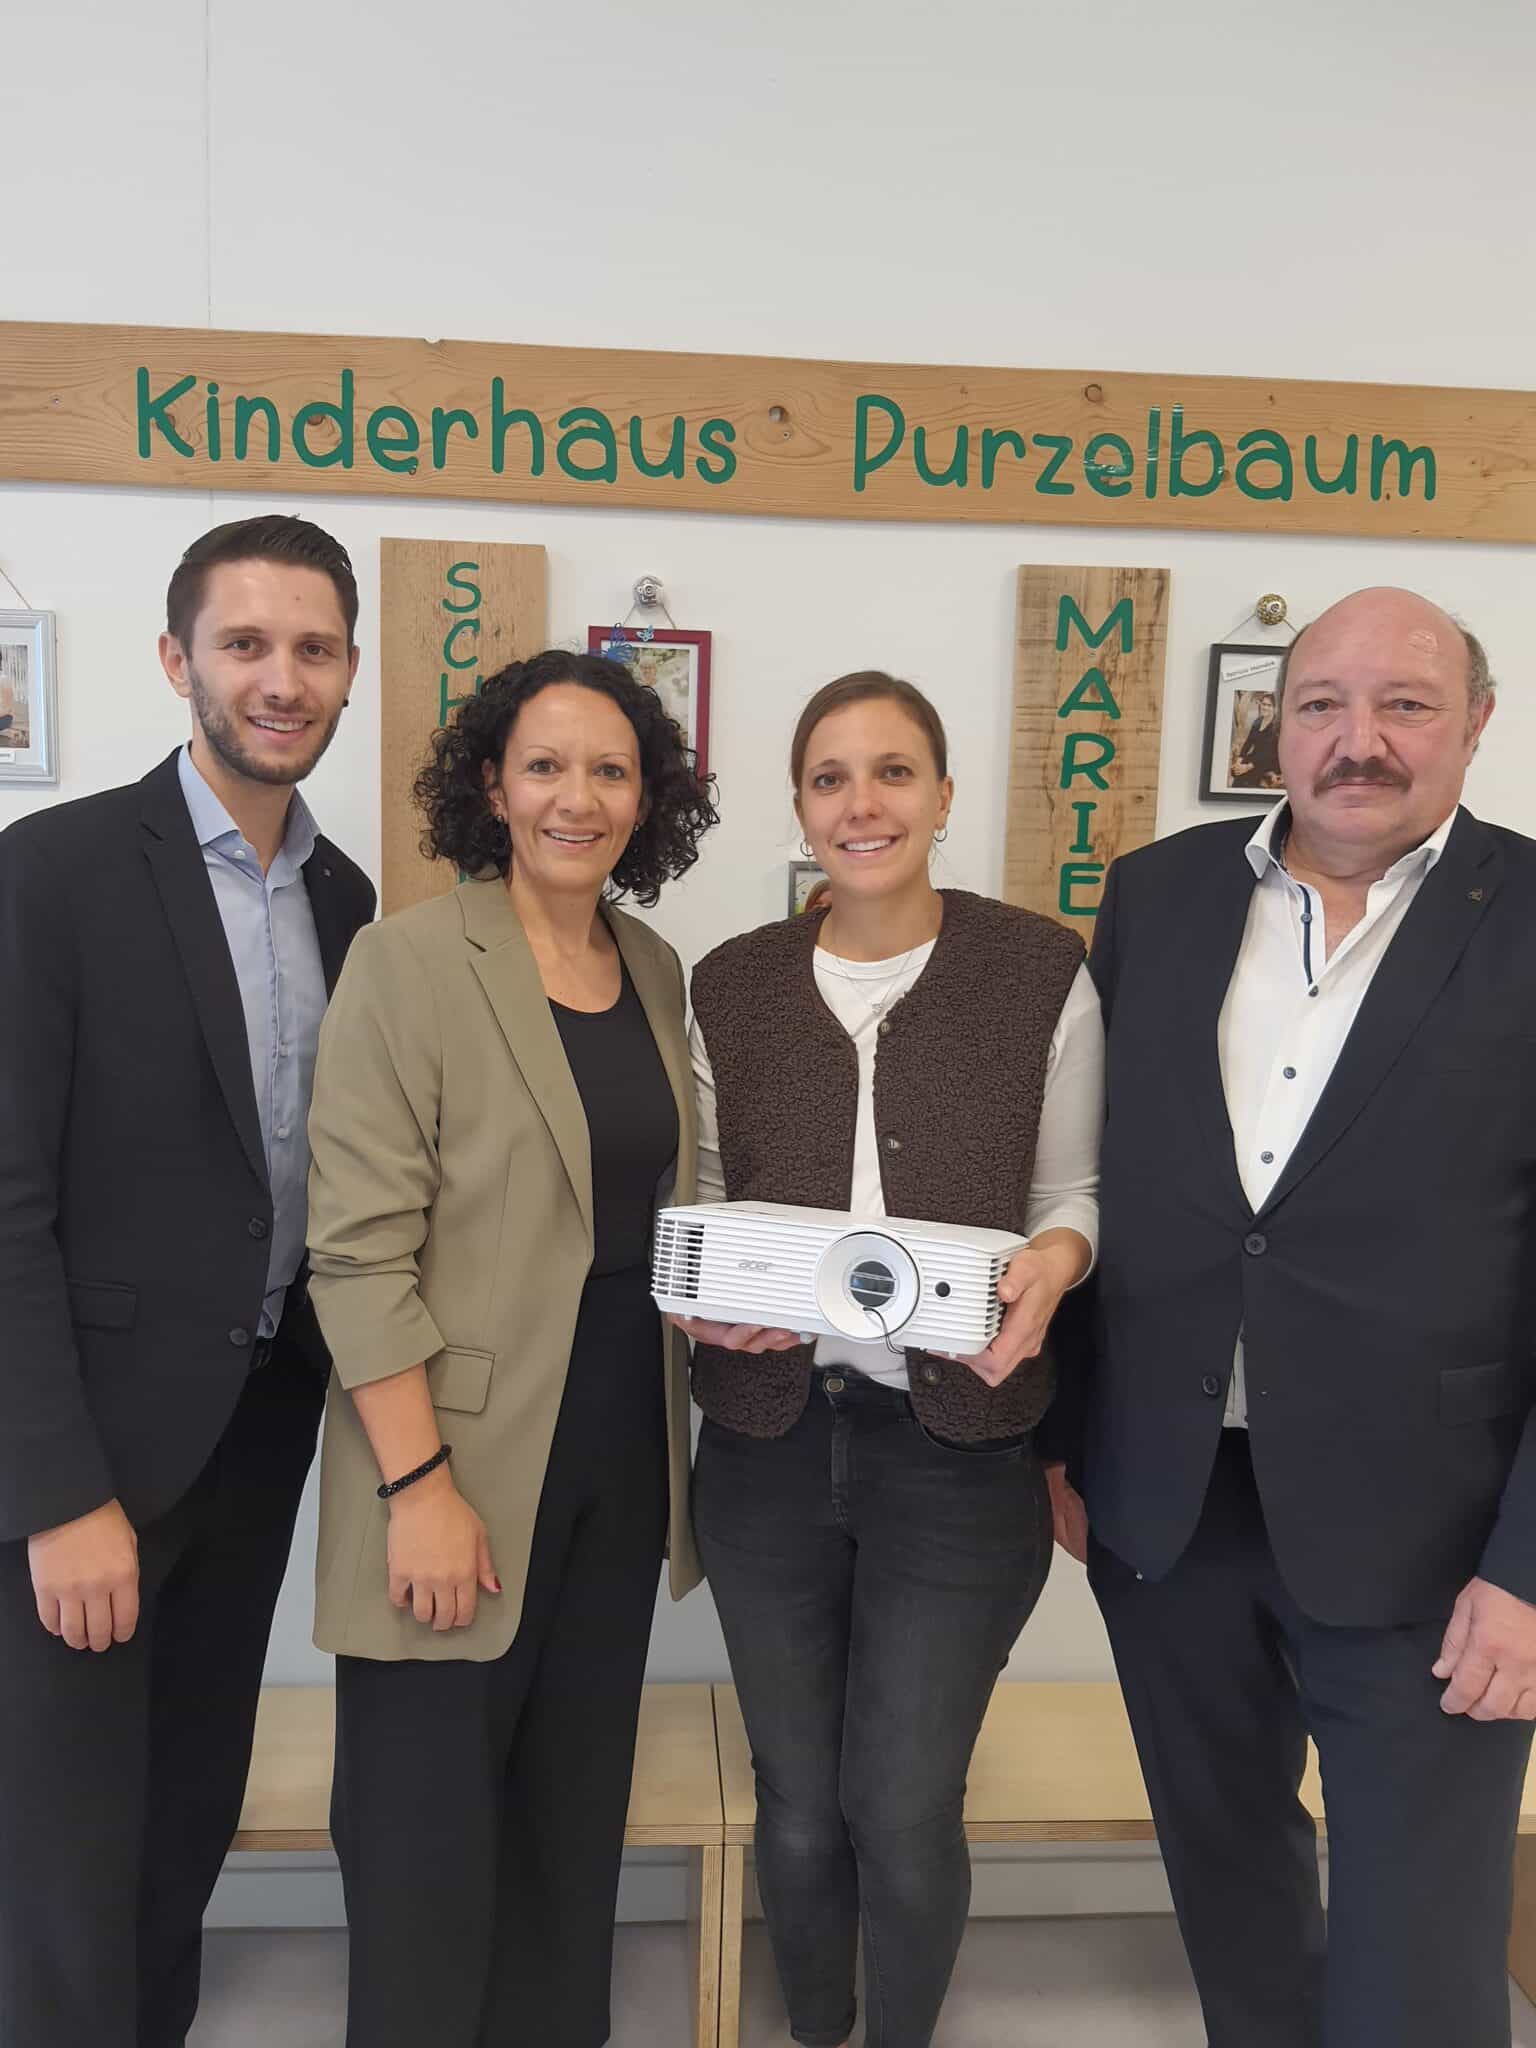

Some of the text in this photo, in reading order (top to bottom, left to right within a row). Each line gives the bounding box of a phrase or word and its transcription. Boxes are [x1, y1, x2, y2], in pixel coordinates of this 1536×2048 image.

[136, 366, 1437, 502] Kinderhaus Purzelbaum
[1055, 595, 1134, 917] MARIE
[737, 1258, 773, 1272] acer
